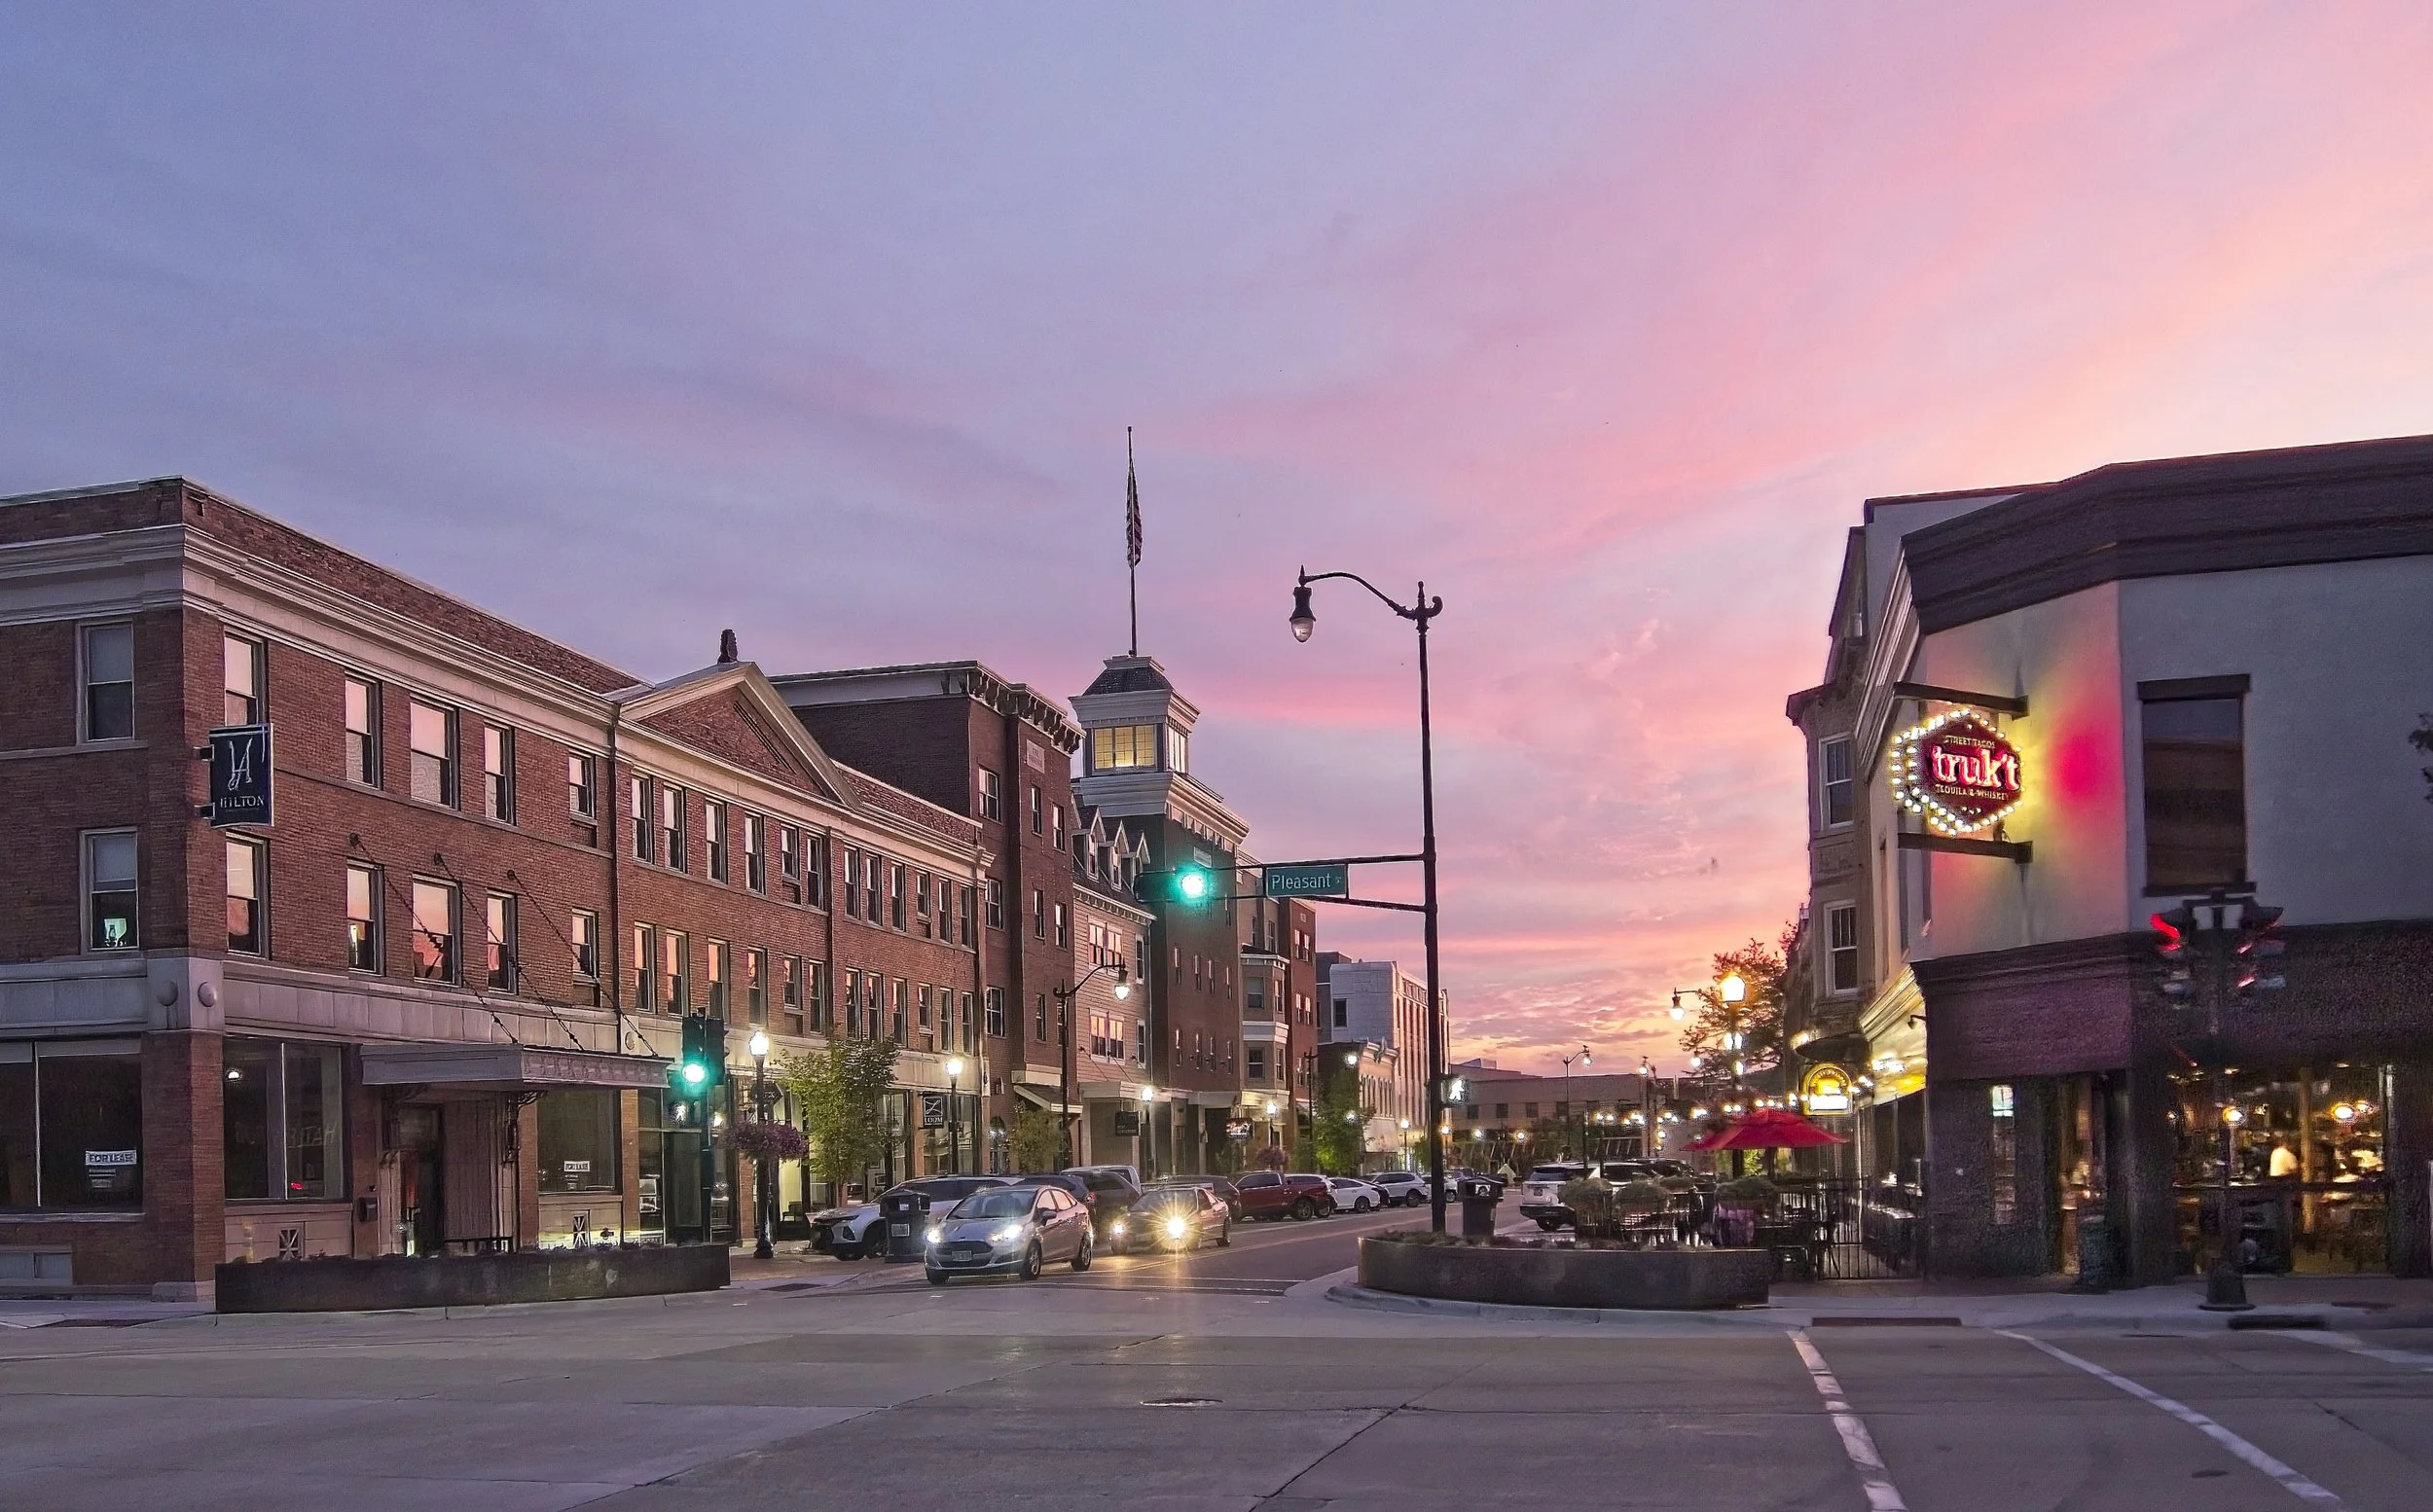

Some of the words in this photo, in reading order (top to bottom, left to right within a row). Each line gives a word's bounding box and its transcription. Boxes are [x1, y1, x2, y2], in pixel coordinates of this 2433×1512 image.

[1943, 735, 1971, 745] STREET
[1973, 738, 1996, 749] TACOS
[1935, 783, 1968, 796] TEQUILA
[220, 795, 265, 809] HILTON
[1272, 874, 1330, 889] Pleasant
